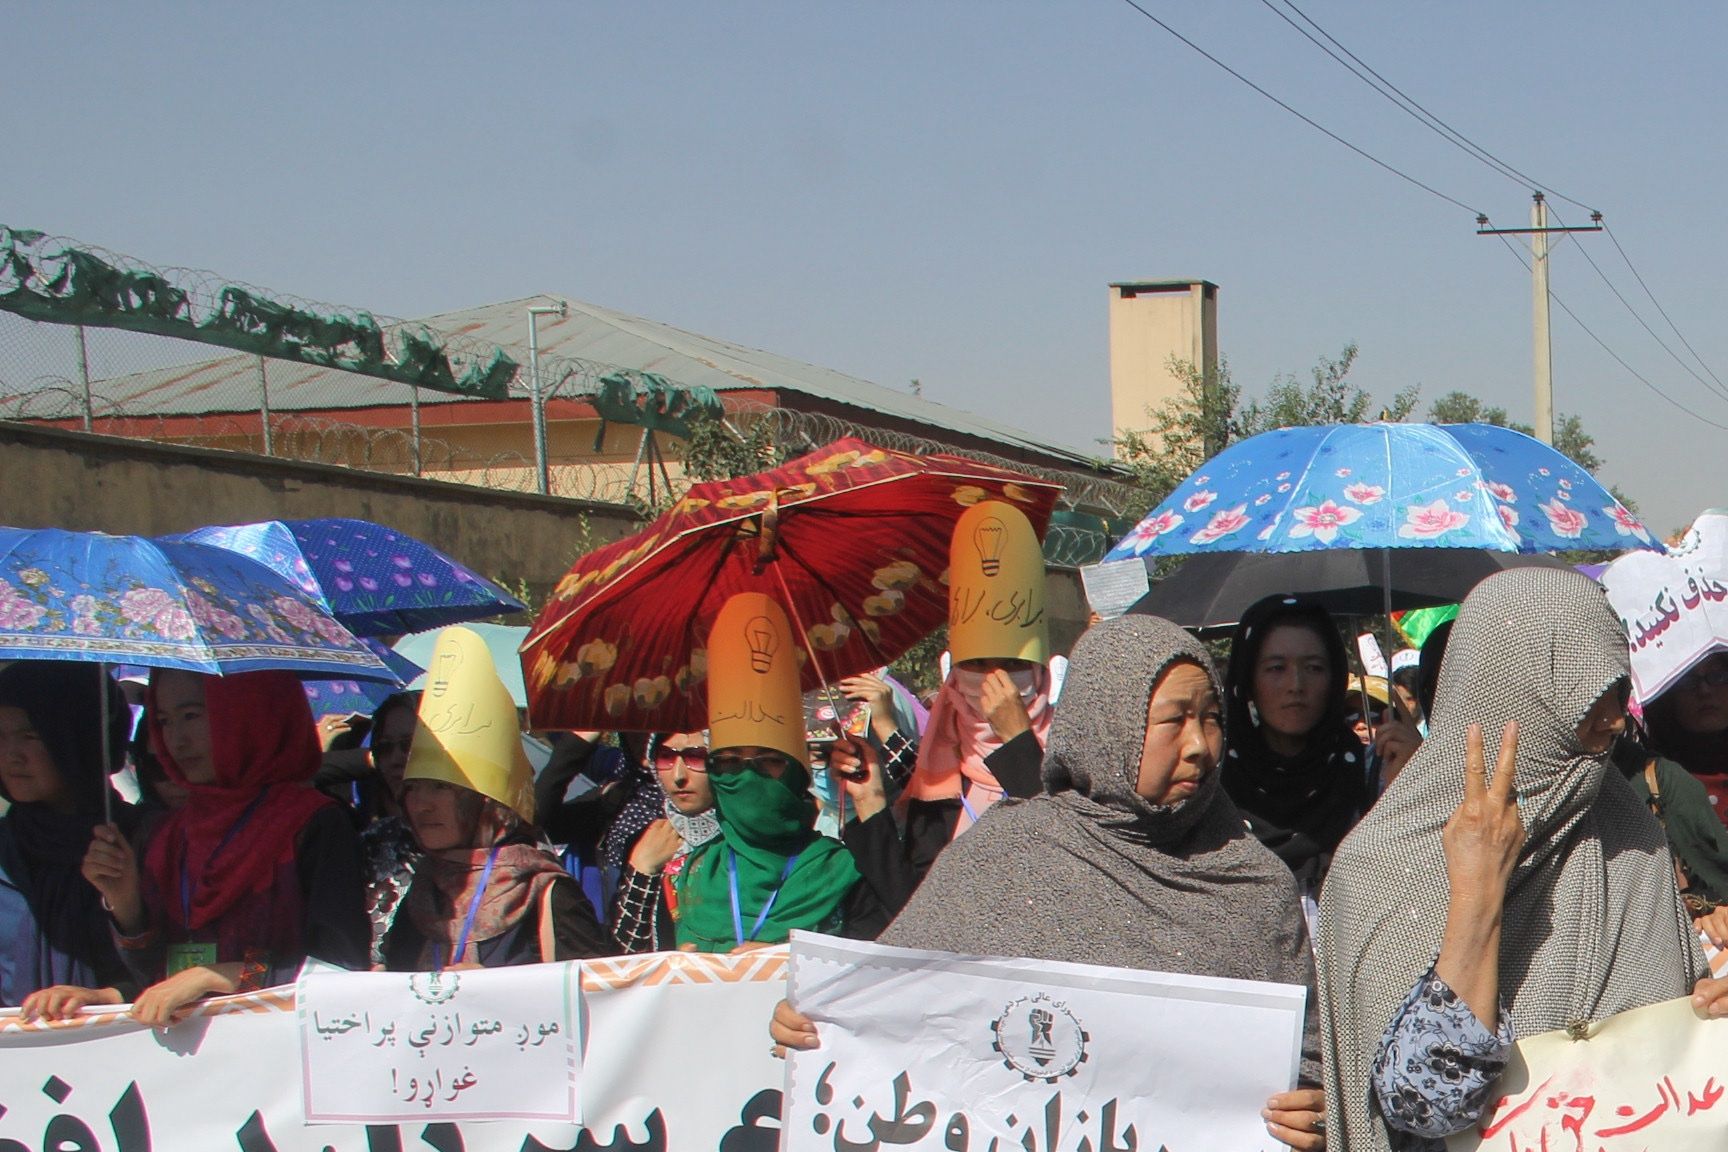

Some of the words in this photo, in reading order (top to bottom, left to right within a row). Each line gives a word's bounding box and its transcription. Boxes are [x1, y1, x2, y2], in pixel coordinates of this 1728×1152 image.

[1681, 567, 1728, 610] حذف
[711, 699, 784, 725] عدالت
[1594, 1074, 1725, 1138] عدالت
